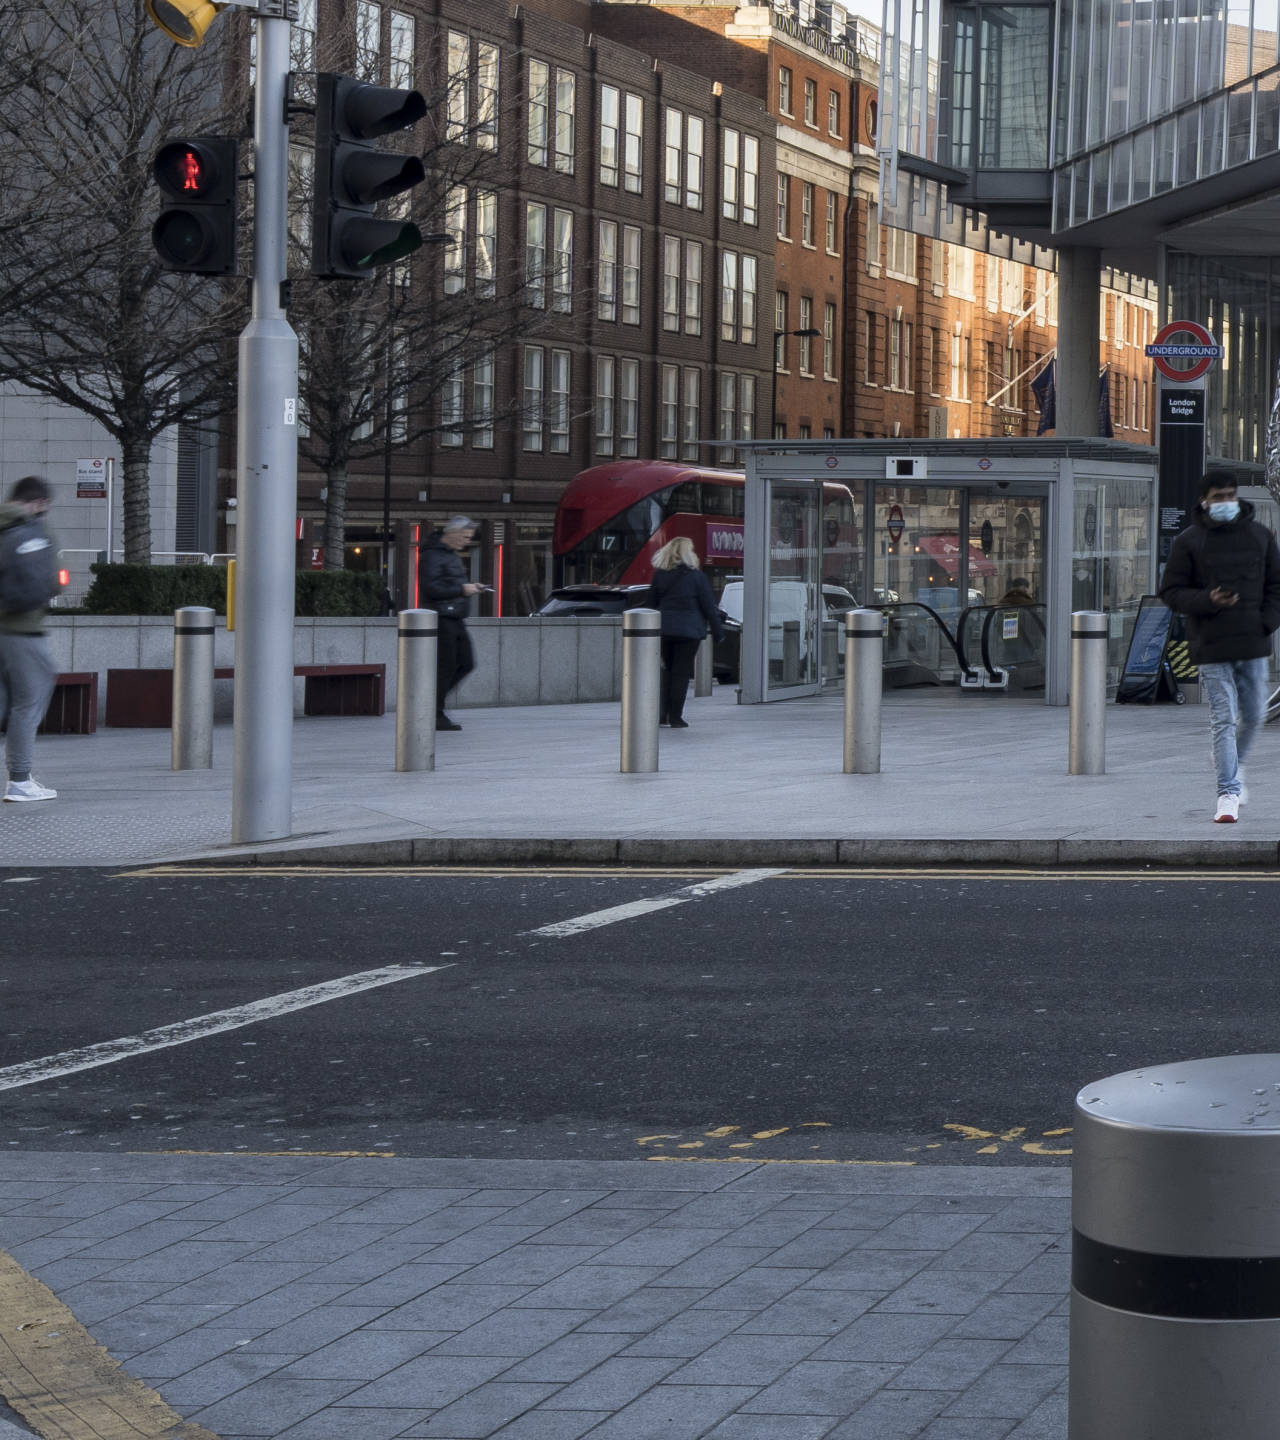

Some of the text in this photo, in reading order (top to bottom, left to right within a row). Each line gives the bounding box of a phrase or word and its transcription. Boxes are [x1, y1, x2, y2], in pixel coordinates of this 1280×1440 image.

[806, 31, 831, 57] BRIDGE
[833, 44, 855, 68] HOTEL
[1147, 346, 1218, 356] UNDERGROUND
[1171, 407, 1194, 415] Bridge
[602, 536, 616, 551] 17
